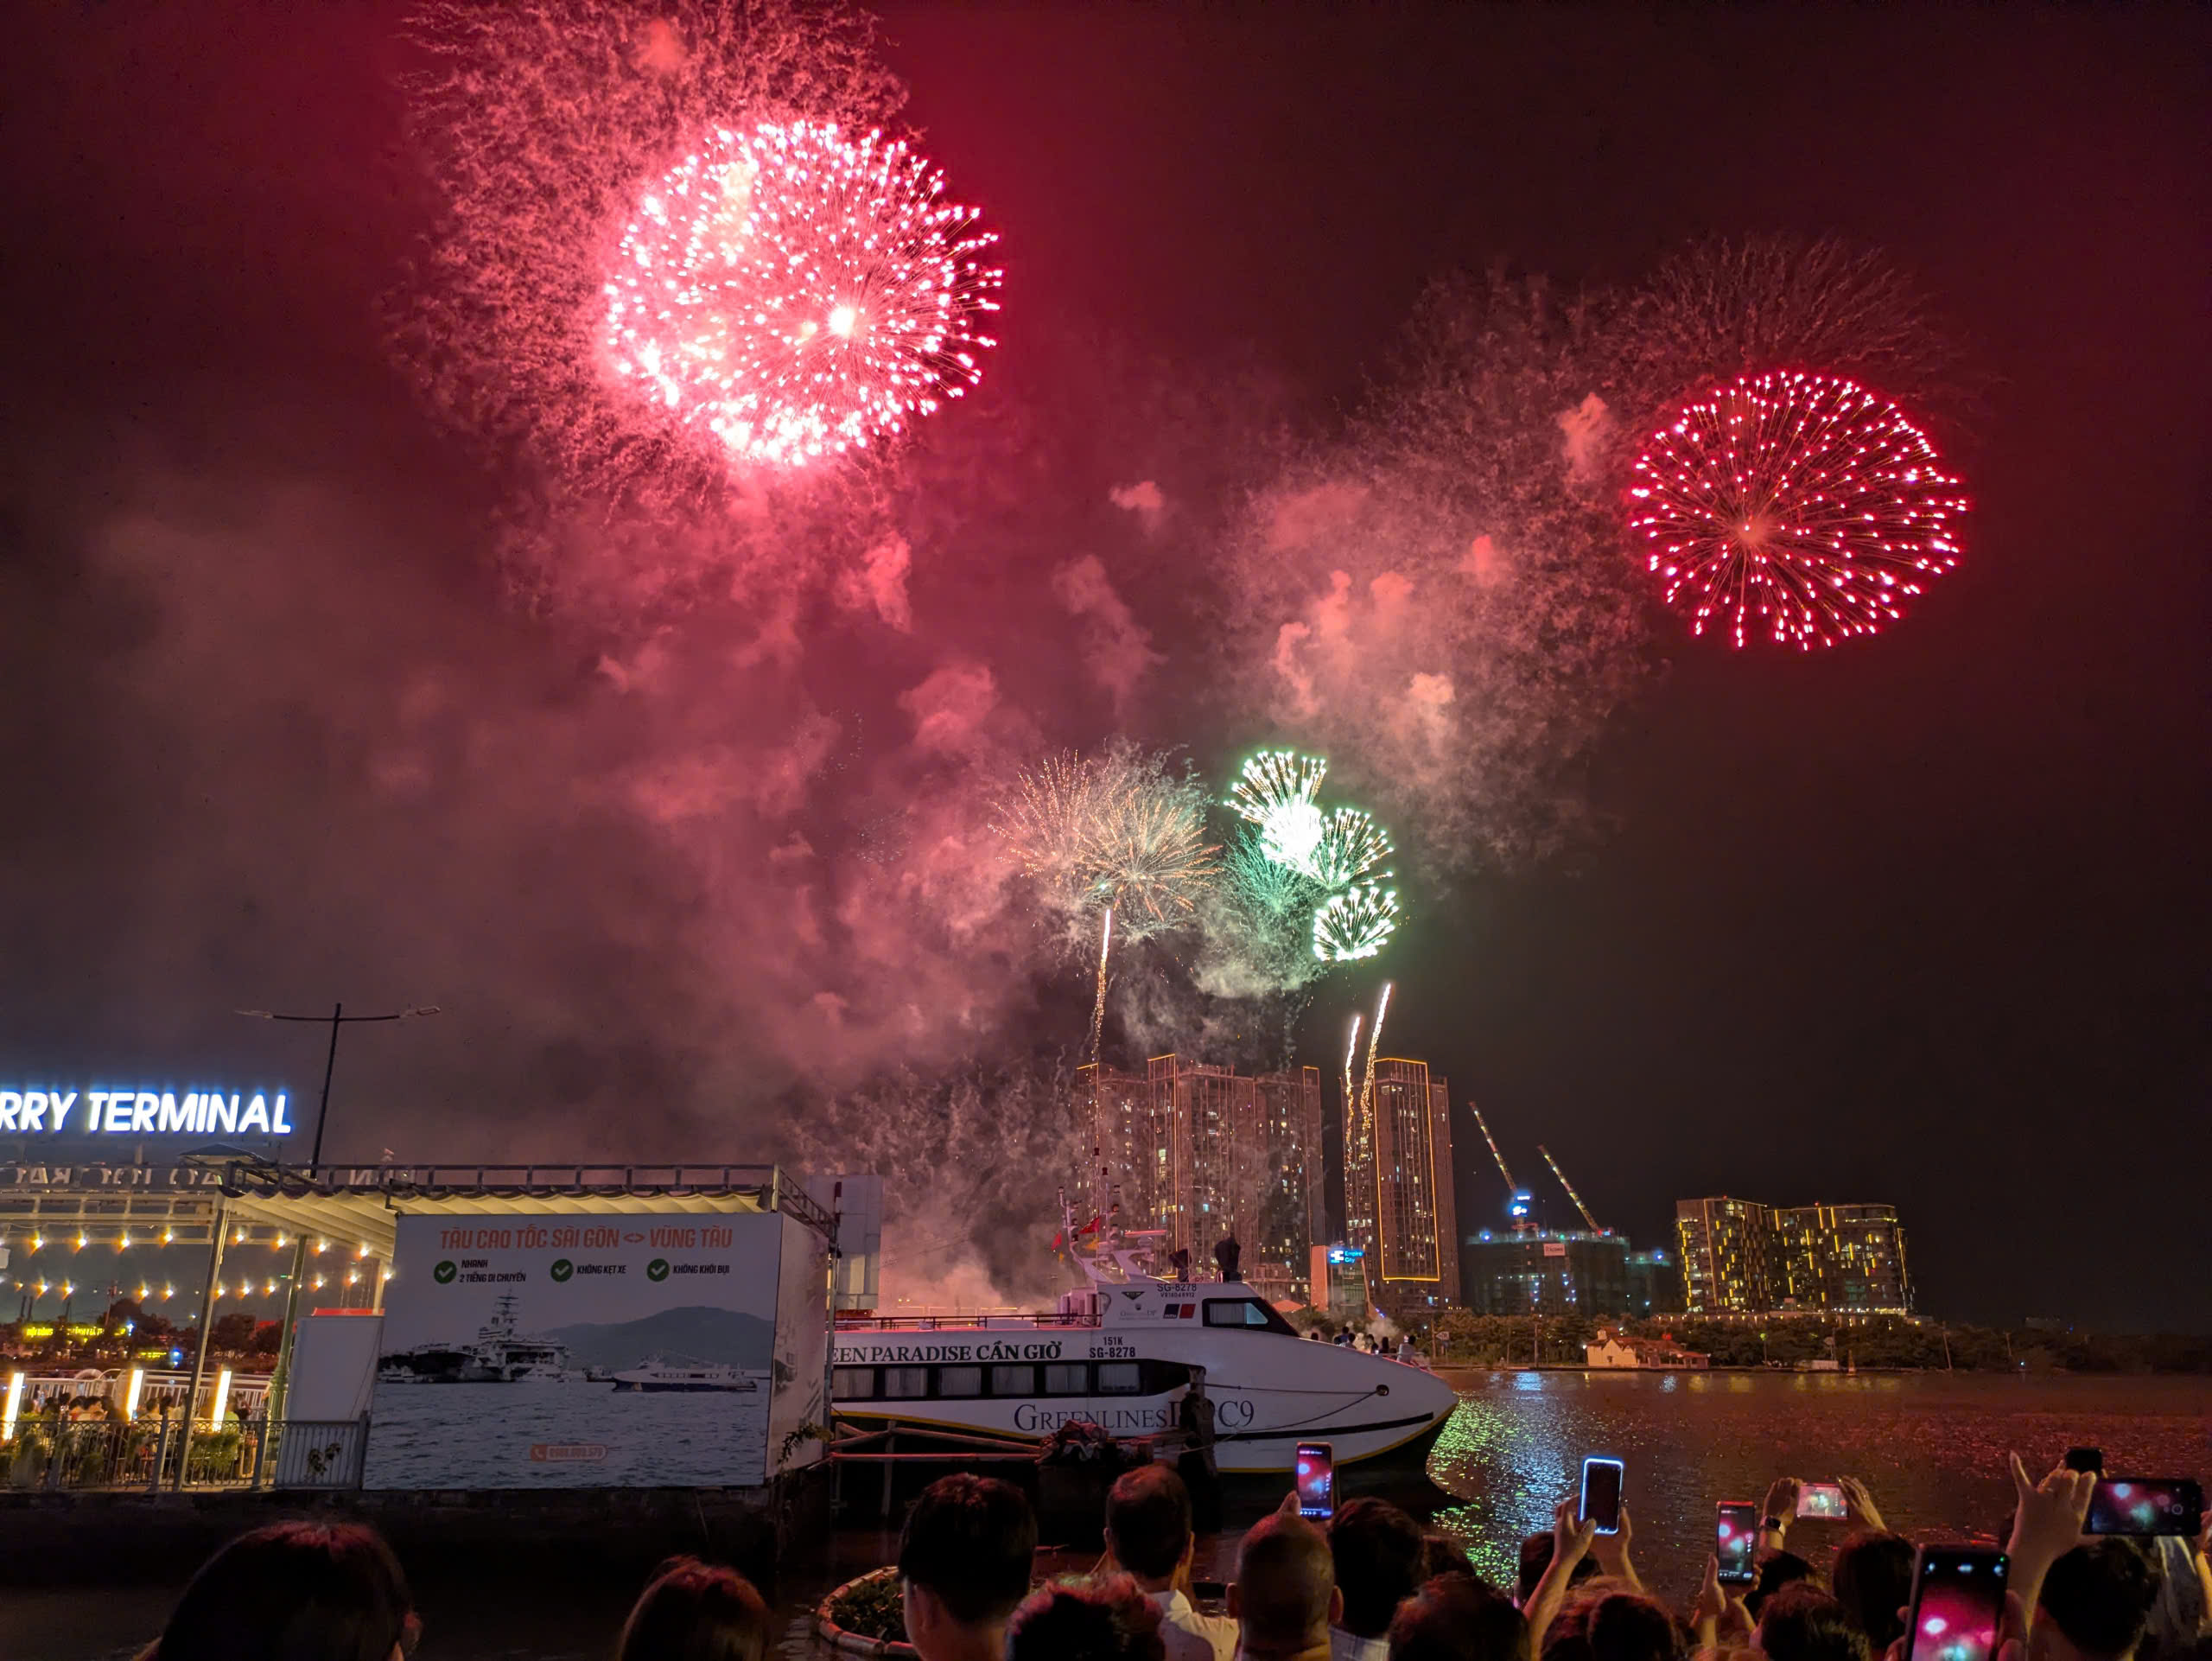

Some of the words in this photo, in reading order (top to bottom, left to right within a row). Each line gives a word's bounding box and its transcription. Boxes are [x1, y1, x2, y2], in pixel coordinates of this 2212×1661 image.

[0, 1091, 78, 1131] RRY
[88, 1092, 291, 1133] TERMINAL
[441, 1226, 473, 1249] TÀU
[476, 1229, 512, 1249] CAO
[517, 1224, 548, 1249] TỐC
[551, 1225, 580, 1248] SÀI
[583, 1225, 620, 1248] GÒN
[650, 1225, 696, 1248] VŨNG
[701, 1225, 733, 1248] TÀU
[461, 1259, 488, 1269] NHANH
[577, 1263, 602, 1275] KHÔNG
[603, 1264, 616, 1276] KẸT
[617, 1264, 626, 1274] XE
[673, 1263, 698, 1275] KHÔNG
[717, 1264, 730, 1276] BỤI
[1157, 1283, 1197, 1292] SG-8278
[1103, 1336, 1123, 1346] 151K
[870, 1345, 971, 1363] PARADISE
[976, 1340, 1019, 1361] CẦN
[1023, 1340, 1063, 1360] GIỜ
[1089, 1346, 1136, 1359] SG-8278
